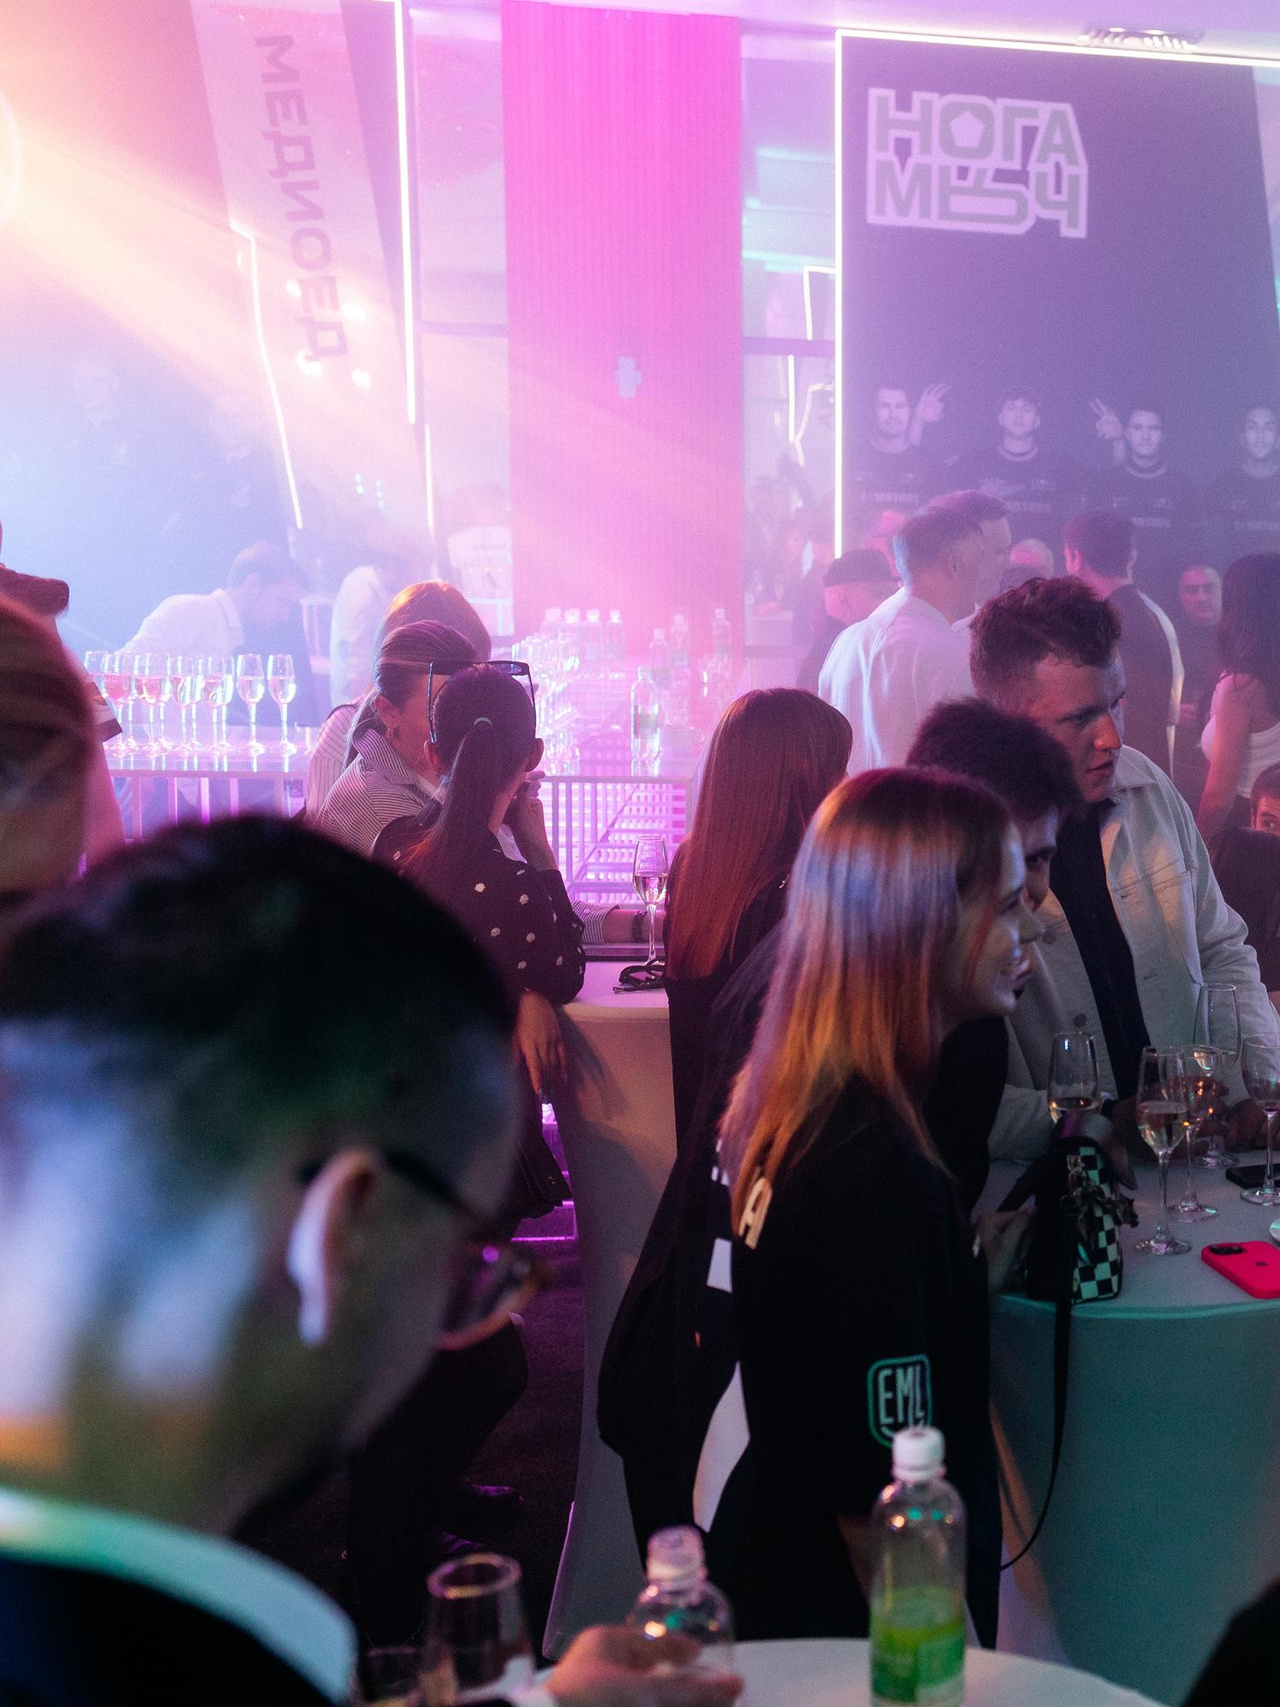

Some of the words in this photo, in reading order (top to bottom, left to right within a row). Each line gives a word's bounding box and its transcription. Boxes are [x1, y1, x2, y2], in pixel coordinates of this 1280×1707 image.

[868, 88, 1087, 168] НОГА
[254, 35, 349, 362] МЕДИОЕД
[878, 1364, 926, 1427] EML
